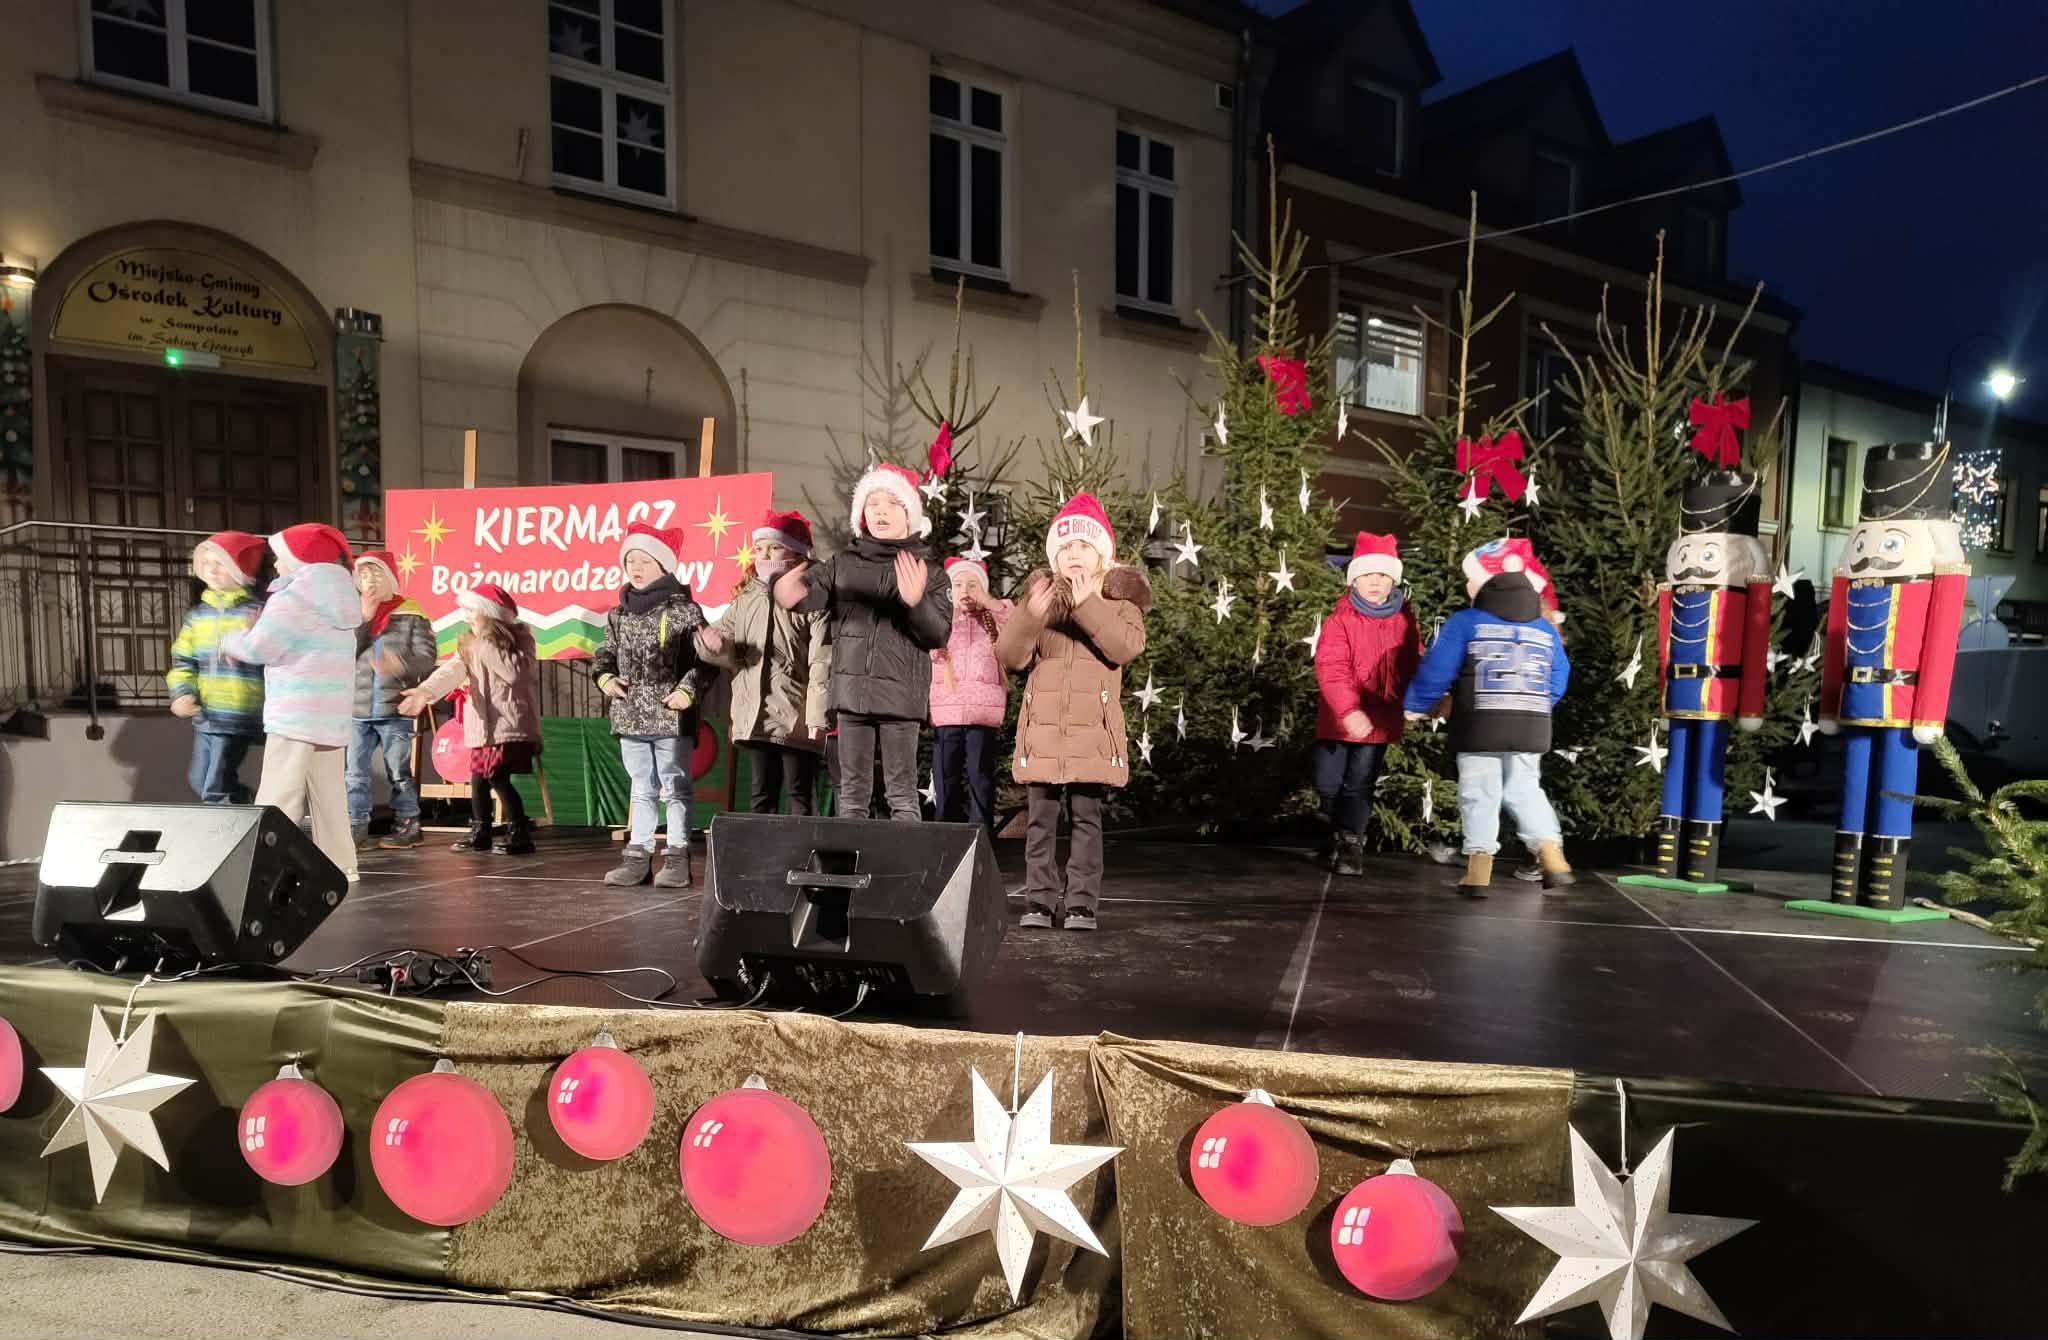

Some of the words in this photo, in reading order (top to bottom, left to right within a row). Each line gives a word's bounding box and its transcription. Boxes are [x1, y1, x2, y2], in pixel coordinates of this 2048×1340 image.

[117, 259, 260, 299] Miejsko-Gminny
[88, 280, 188, 309] Ośrodek
[193, 296, 282, 327] Kultury
[139, 315, 154, 325] w
[161, 317, 241, 337] Sompolnie
